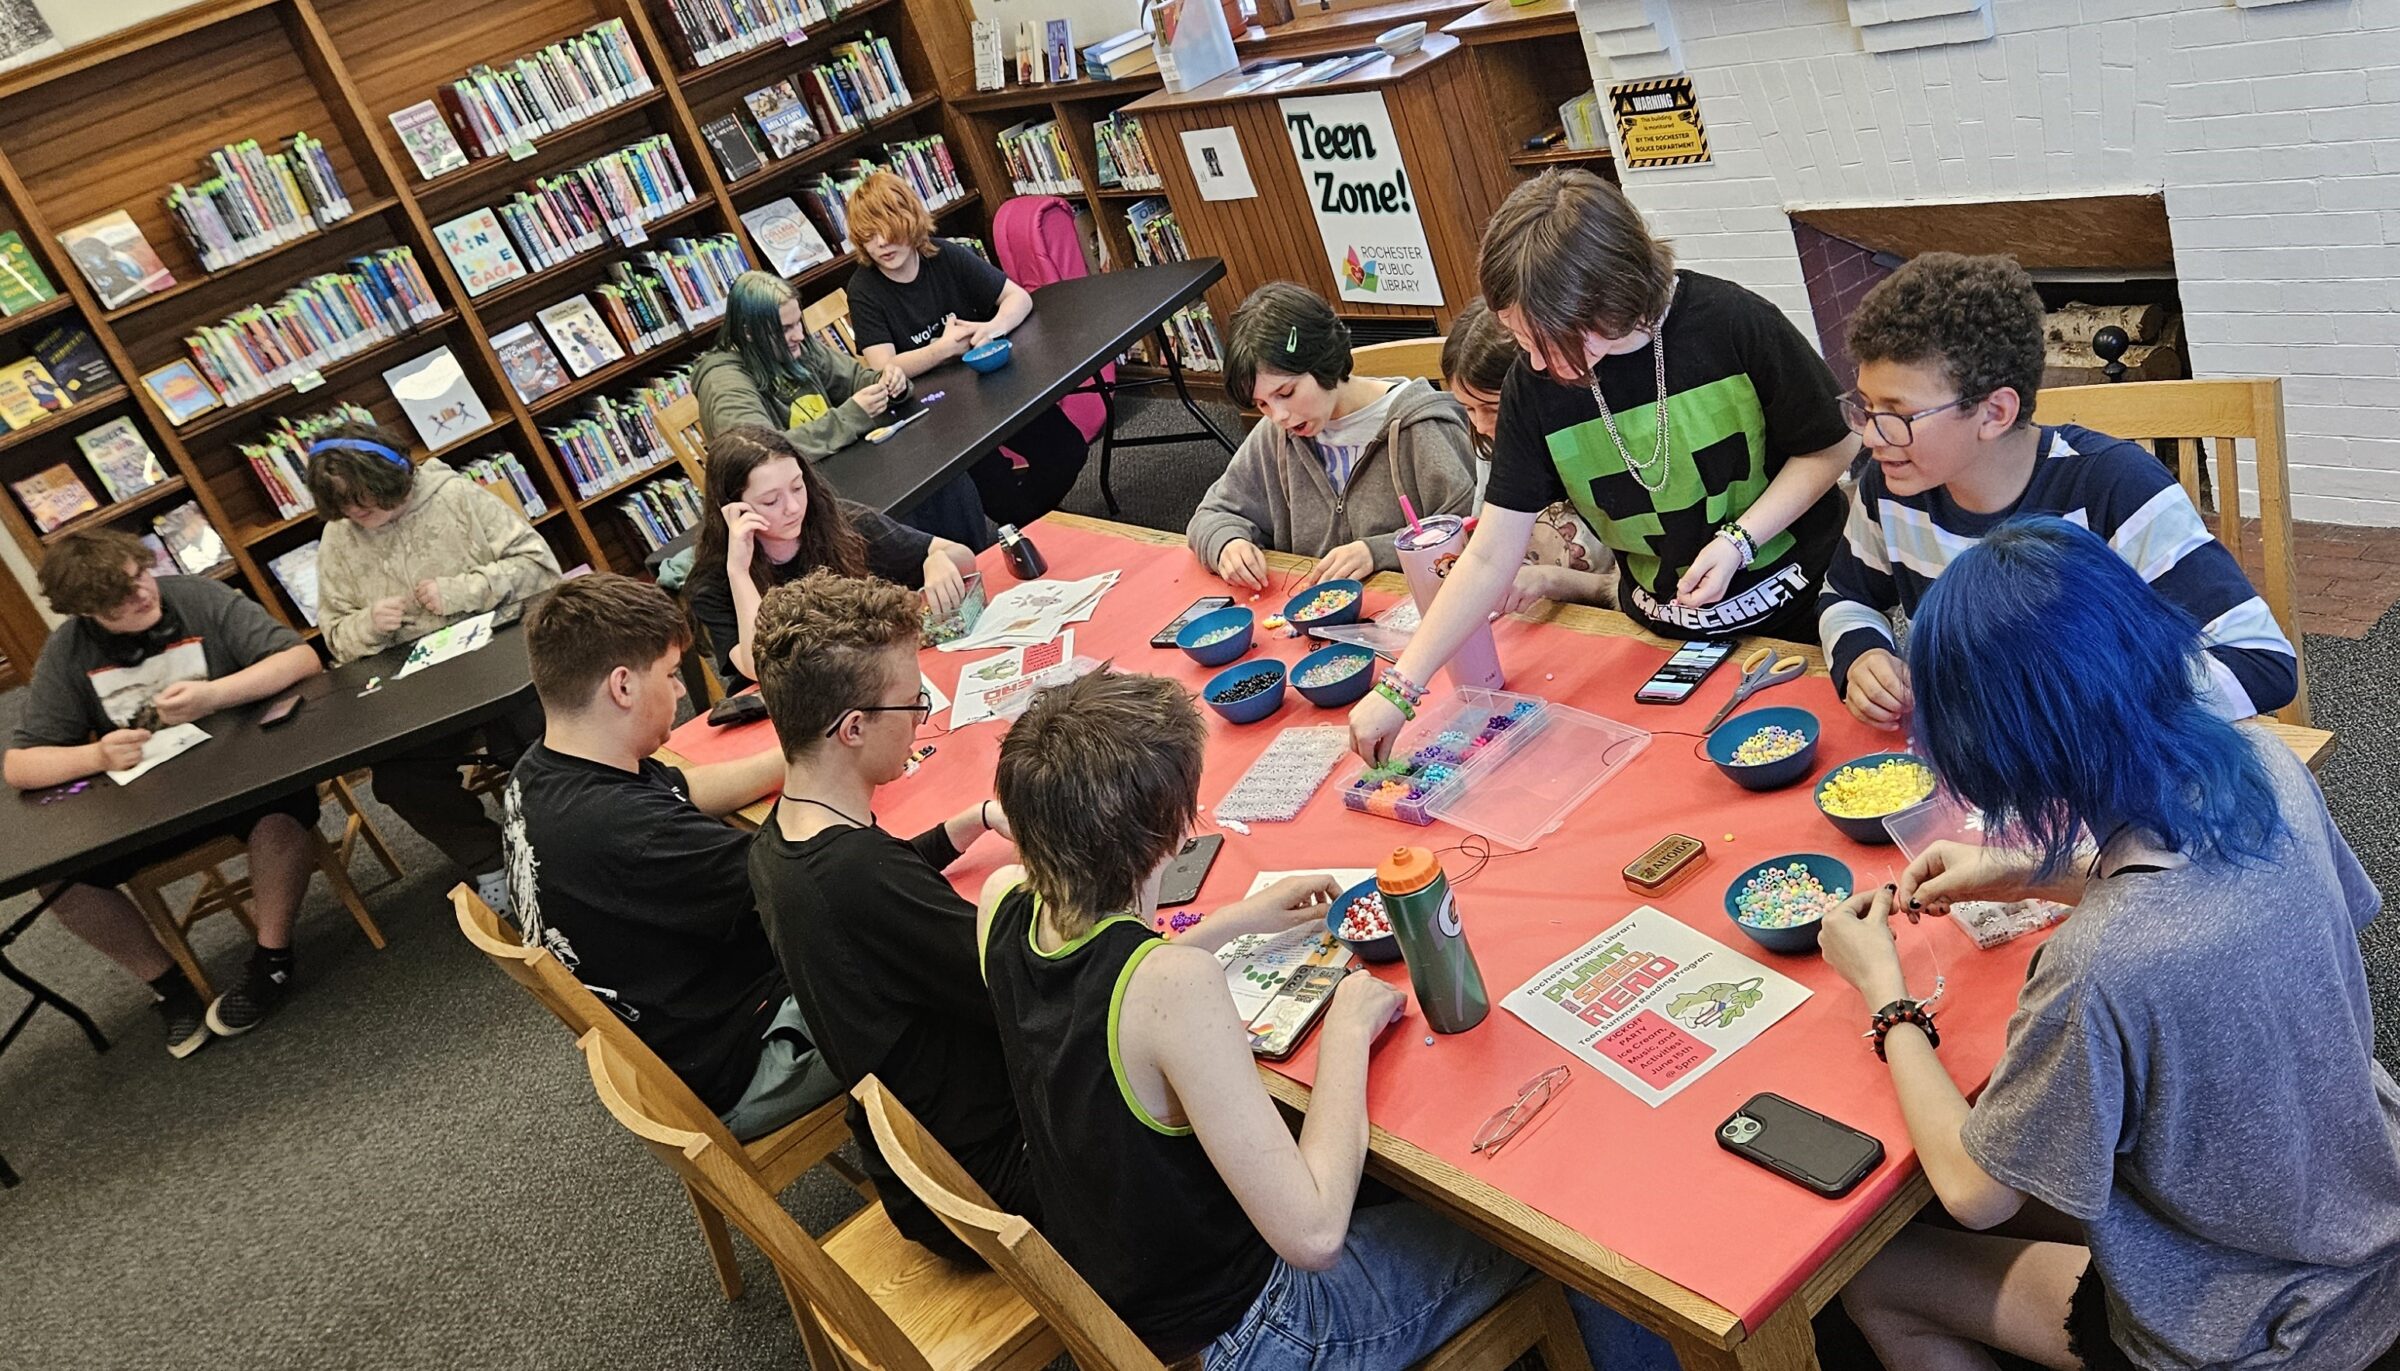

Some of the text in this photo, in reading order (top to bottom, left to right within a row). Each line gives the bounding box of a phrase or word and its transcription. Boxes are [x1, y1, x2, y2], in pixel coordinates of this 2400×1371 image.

[1632, 93, 1674, 111] WARNING
[766, 112, 802, 132] MILITARY
[1287, 113, 1376, 159] Teen
[1655, 132, 1690, 141] ROCHESTER
[1655, 142, 1694, 151] DEPARTMENT
[1314, 169, 1410, 213] Zone!
[1361, 246, 1423, 259] ROCHESTER
[470, 261, 520, 287] GAGA
[1378, 263, 1414, 275] PUBLIC
[1380, 279, 1420, 292] LIBRARY
[1652, 841, 1692, 870] ALTOIDS
[1526, 921, 1637, 996] Rochester Public Library
[1542, 942, 1628, 1003] PLANT
[1559, 951, 1656, 1014] A SEED,
[1576, 955, 1679, 1027] READ
[1578, 951, 1713, 1046] Teen Summer Reading Program
[1607, 1017, 1643, 1043] KICKOFF
[1617, 1027, 1667, 1059] Ice Cream,
[1619, 1026, 1647, 1046] PARTY
[1627, 1031, 1677, 1065] Music, and
[1640, 1039, 1685, 1070] Activities!
[1651, 1045, 1694, 1075] June 15th
[1665, 1055, 1699, 1078] @ 5pm
